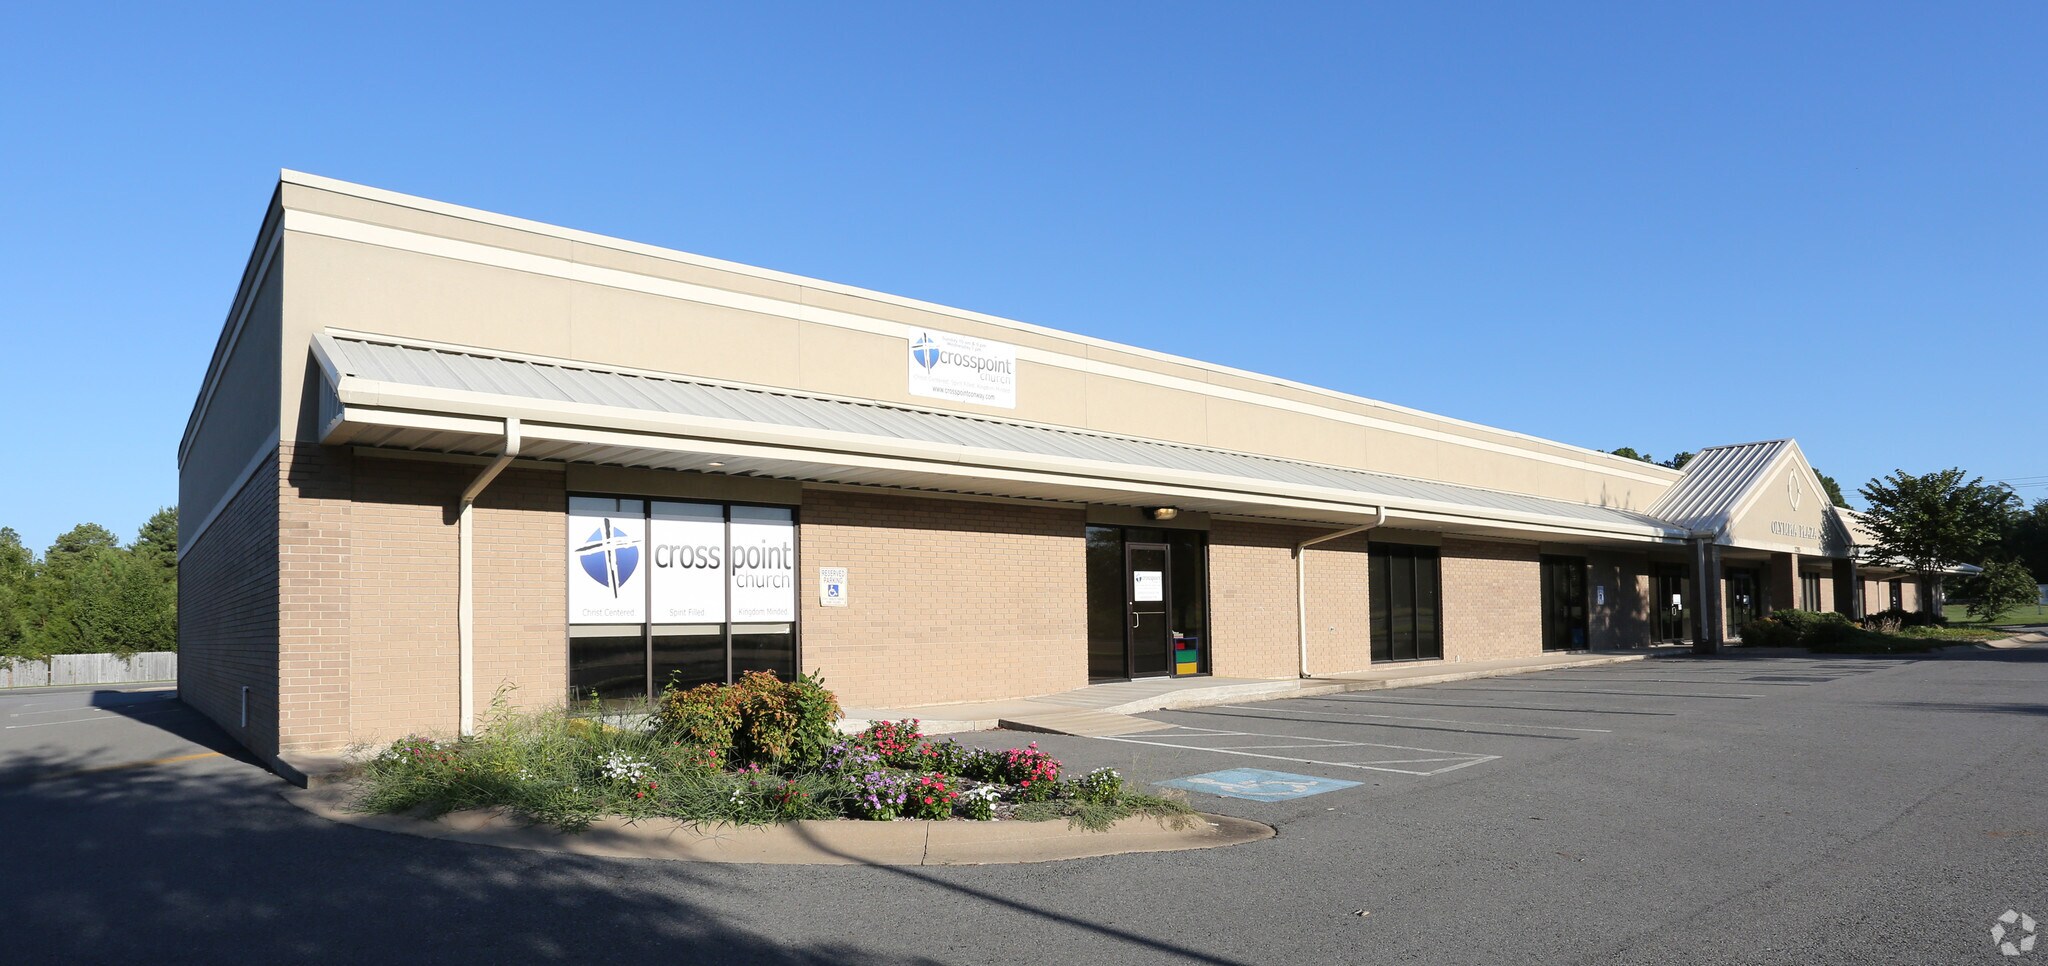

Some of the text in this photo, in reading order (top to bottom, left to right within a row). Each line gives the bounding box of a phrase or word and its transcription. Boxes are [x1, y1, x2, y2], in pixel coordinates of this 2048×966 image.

[940, 350, 1011, 374] crosspoint
[980, 373, 1011, 384] church
[1799, 525, 1817, 540] PLAZA
[655, 539, 791, 576] cross point
[822, 569, 845, 577] RESERVED
[737, 572, 790, 588] church
[583, 608, 602, 617] Christ
[670, 608, 687, 618] Spirit
[738, 608, 765, 618] Kingdom
